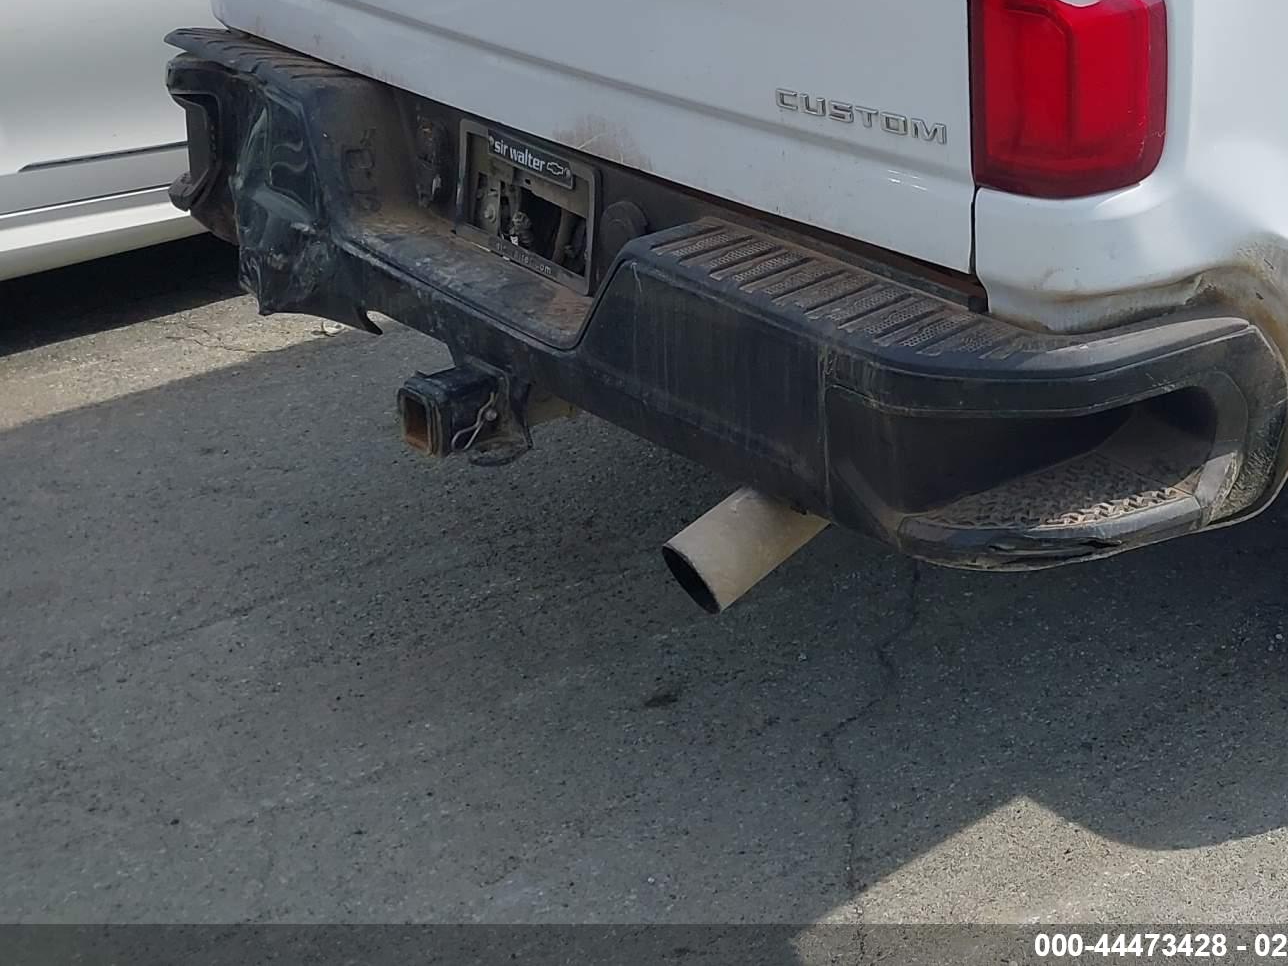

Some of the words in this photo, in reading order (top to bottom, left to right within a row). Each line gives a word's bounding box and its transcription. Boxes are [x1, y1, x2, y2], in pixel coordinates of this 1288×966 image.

[775, 88, 947, 145] CUSTOM
[494, 139, 508, 156] sir
[509, 146, 546, 172] walter
